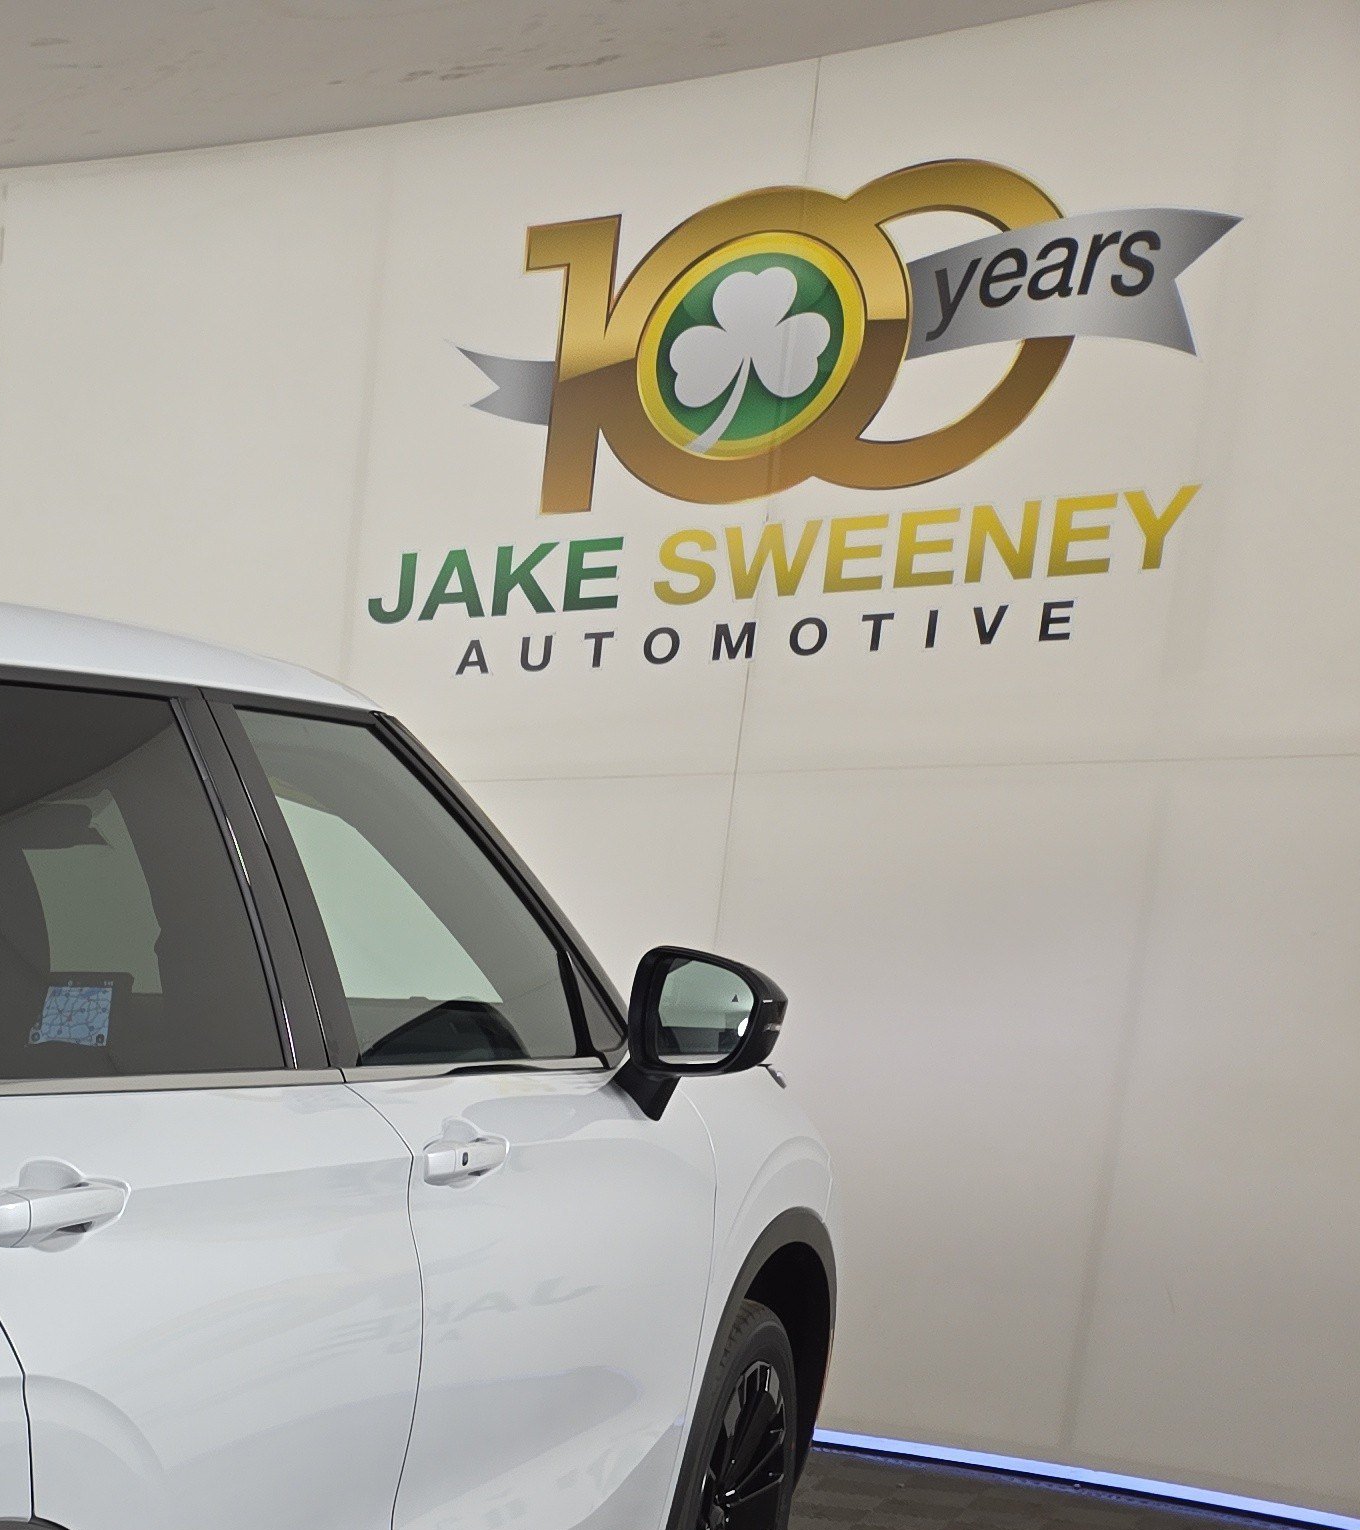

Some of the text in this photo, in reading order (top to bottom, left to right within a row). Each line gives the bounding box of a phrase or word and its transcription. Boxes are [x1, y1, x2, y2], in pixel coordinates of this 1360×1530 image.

[523, 158, 1076, 515] 100
[925, 227, 1162, 344] years
[367, 484, 1203, 625] JAKE SWEENEY
[455, 600, 1074, 677] AUTOMOTIVE
